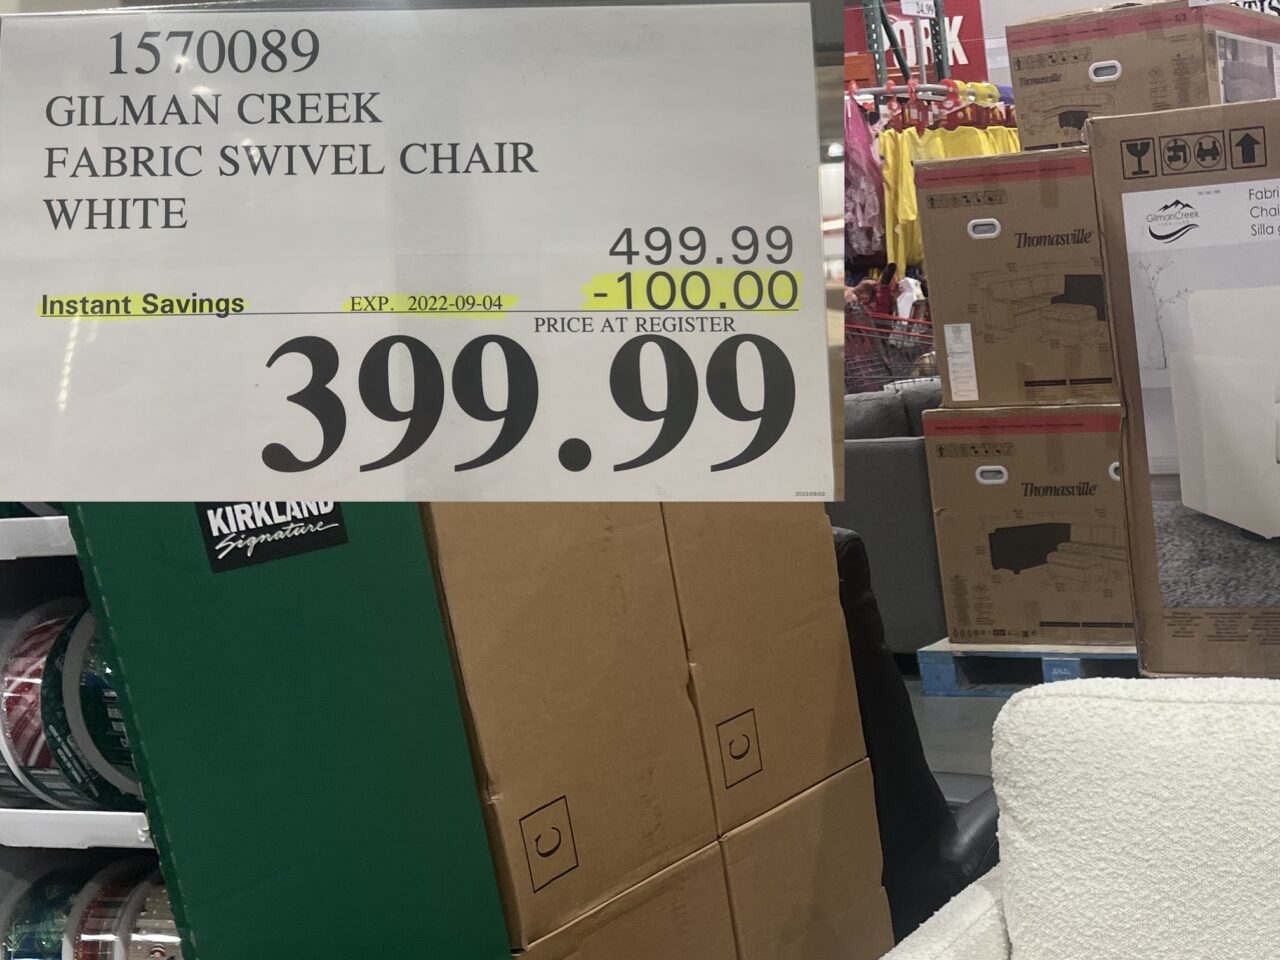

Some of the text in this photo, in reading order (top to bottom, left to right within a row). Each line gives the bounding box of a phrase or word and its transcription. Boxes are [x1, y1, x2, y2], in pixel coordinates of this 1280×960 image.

[109, 28, 320, 75] 1570089
[45, 92, 383, 127] GILMAN CREEK
[44, 142, 539, 179] FABRIC SWIVEL CHAIR
[44, 197, 188, 231] WHITE
[1251, 222, 1274, 237] Silla
[609, 226, 795, 266] 499.99
[1015, 229, 1094, 249] Thomasville
[42, 293, 245, 319] Instant Savings
[350, 294, 504, 312] EXP. 2022-09-04
[594, 270, 800, 311] -100.00
[534, 316, 737, 334] PRICE AT REGISTER
[261, 334, 797, 474] 399.99
[1020, 482, 1097, 498] Thomasville
[215, 521, 340, 560] Signature
[729, 733, 751, 761] C
[535, 825, 562, 859] C
